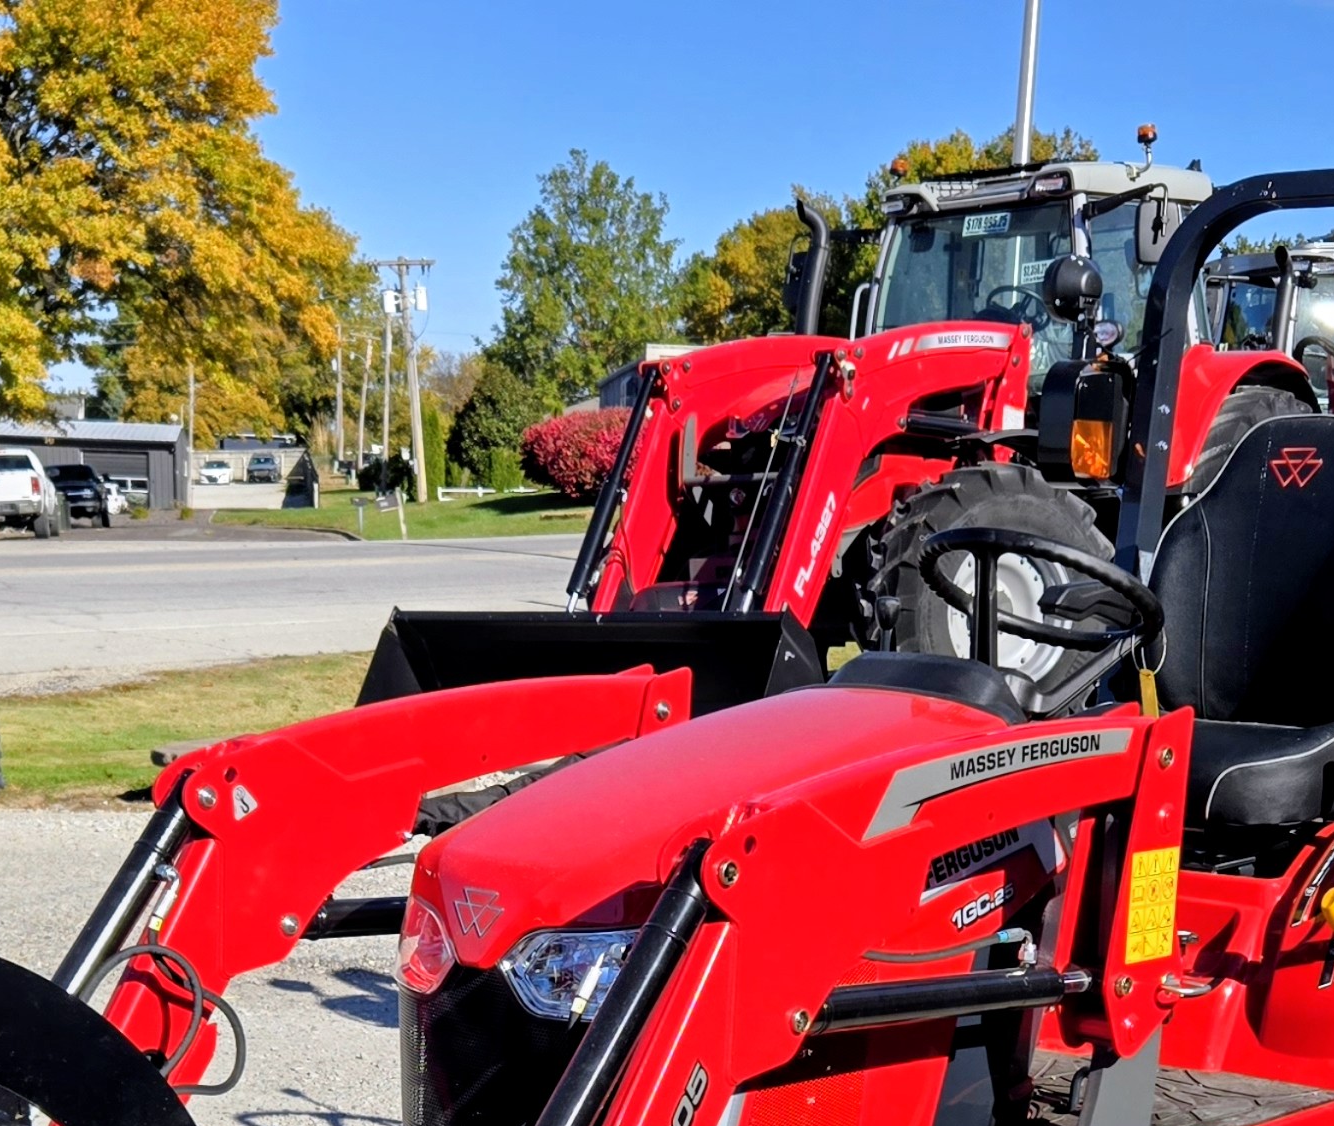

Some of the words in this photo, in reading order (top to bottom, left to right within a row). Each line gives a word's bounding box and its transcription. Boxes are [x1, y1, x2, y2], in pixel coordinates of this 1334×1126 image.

[937, 335, 963, 345] MASSEY
[963, 334, 995, 344] FERGUSON
[950, 747, 1016, 780] MASSEY
[1021, 733, 1102, 763] FERGUSON
[951, 882, 1015, 932] 1GC.25
